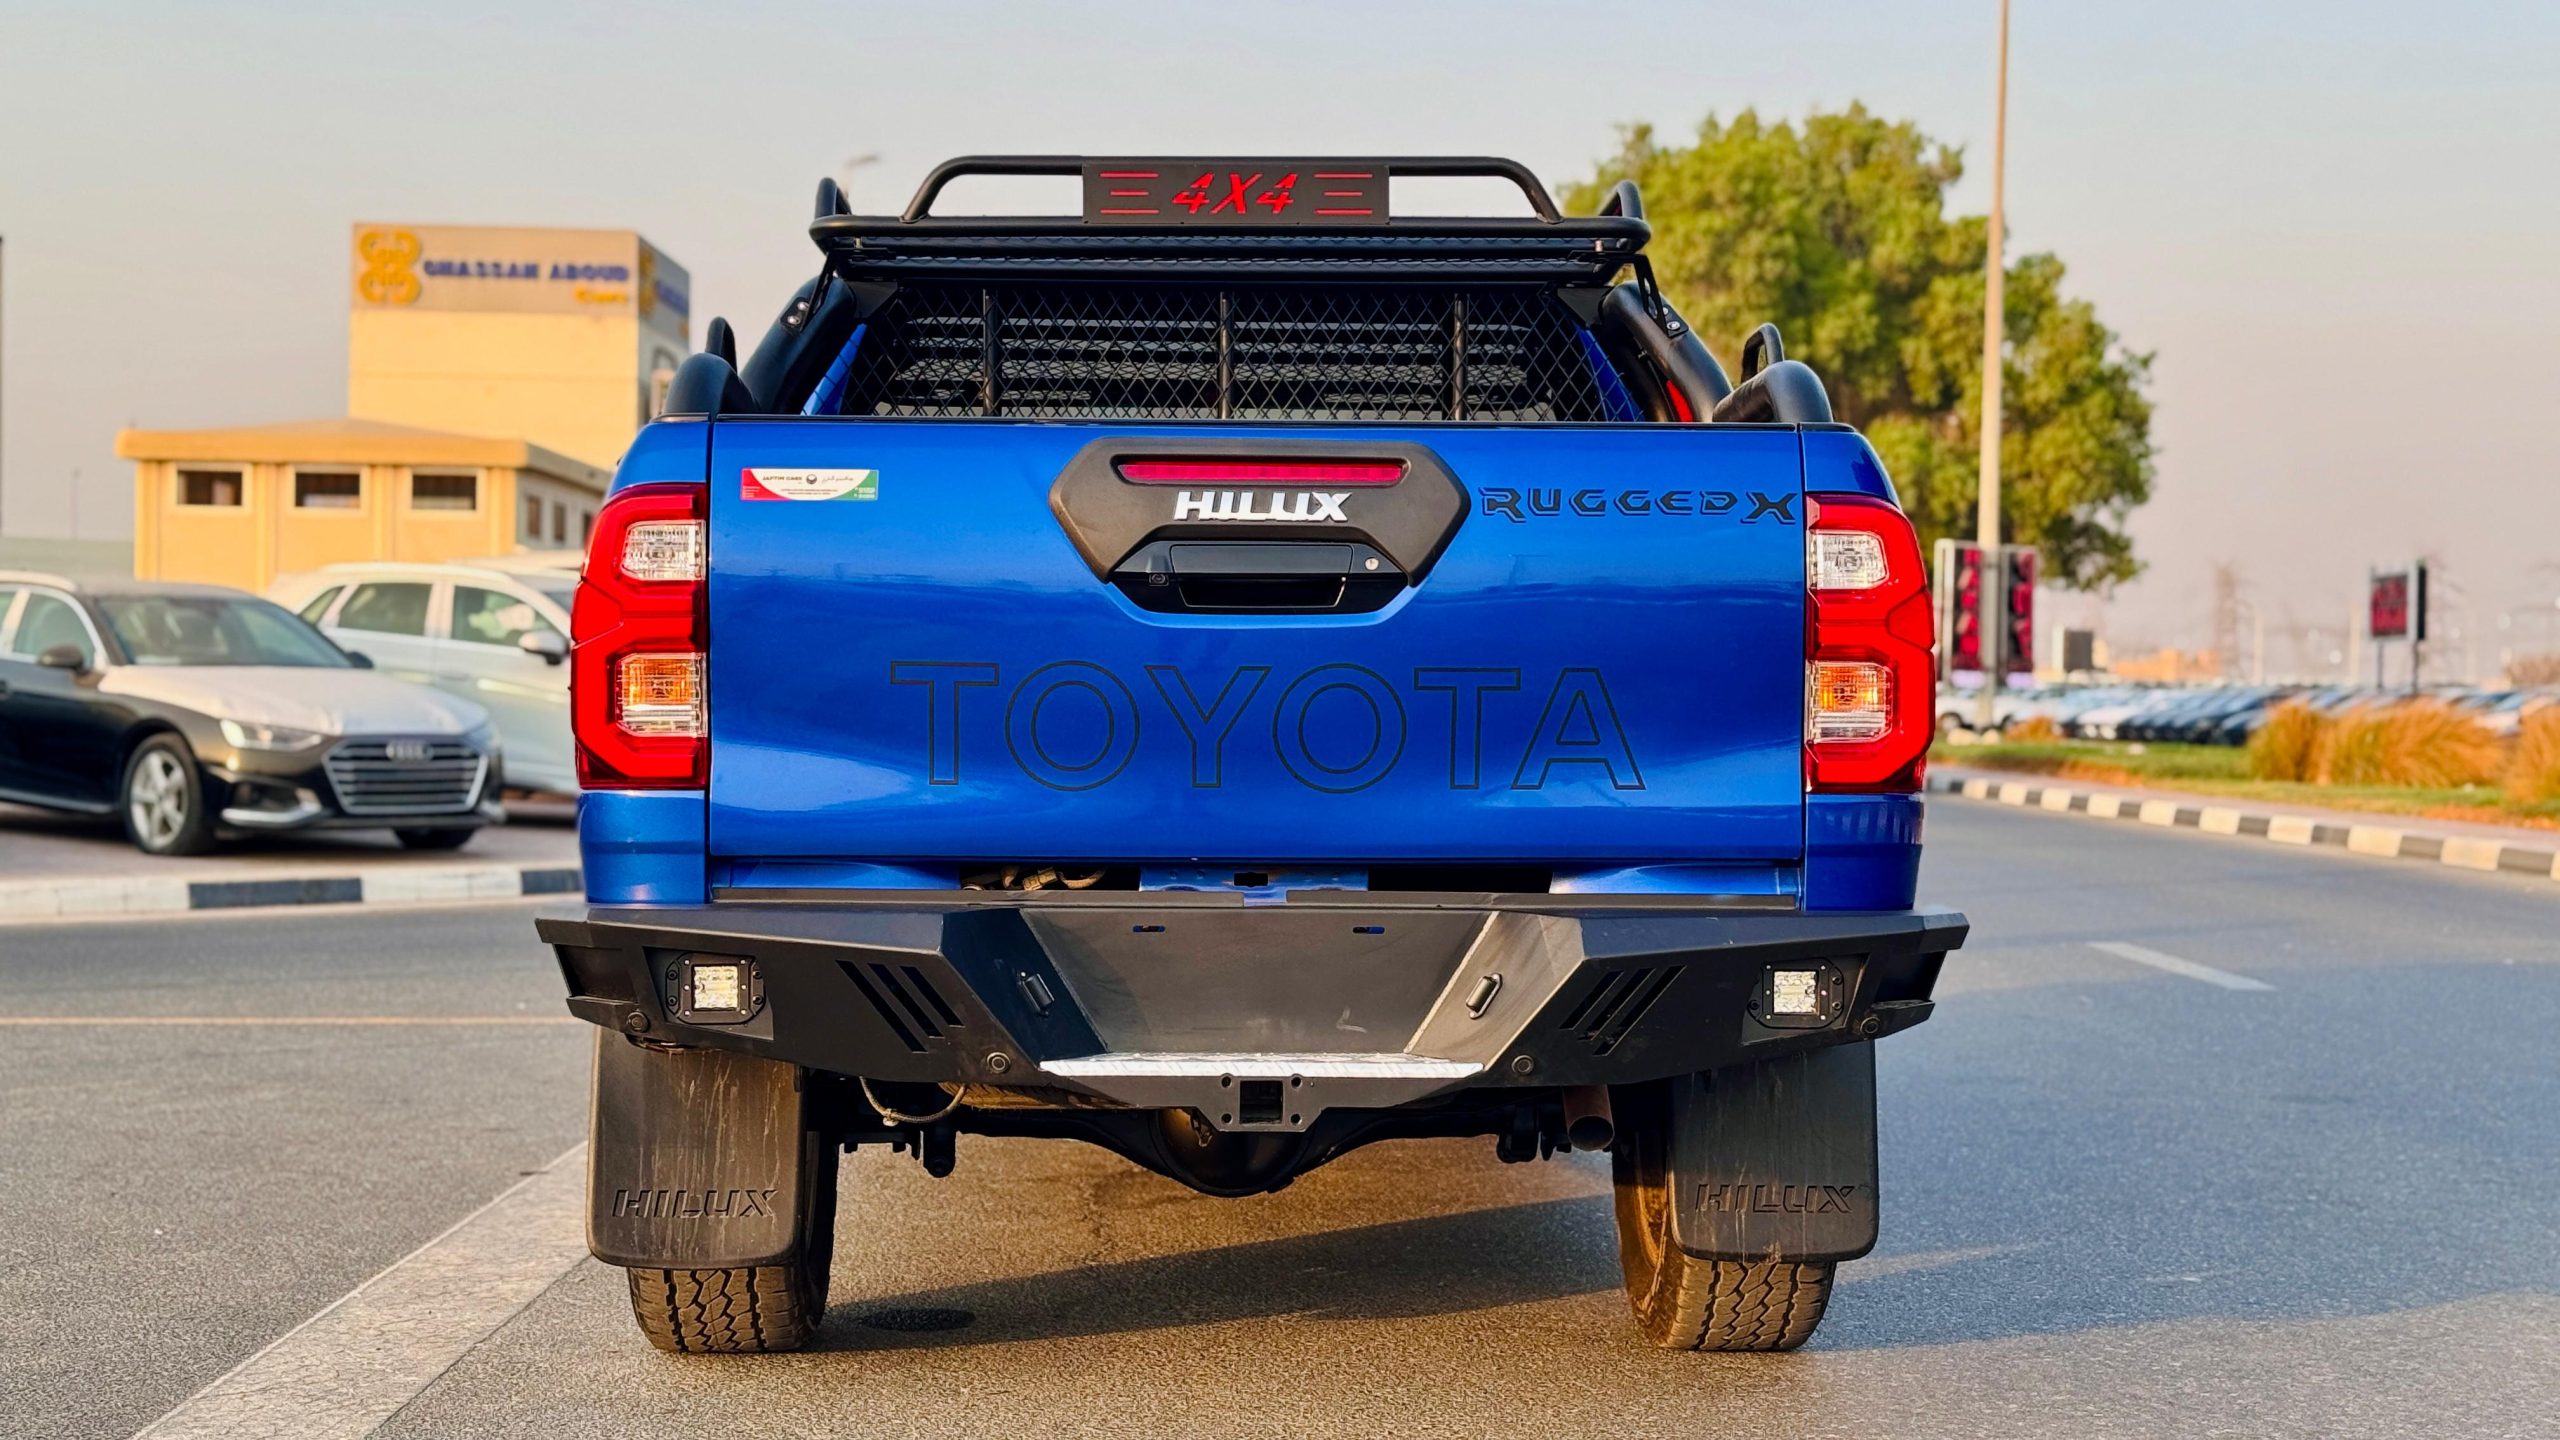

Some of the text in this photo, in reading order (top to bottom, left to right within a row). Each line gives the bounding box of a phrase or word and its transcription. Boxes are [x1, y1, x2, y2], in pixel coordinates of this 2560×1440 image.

[1172, 172, 1298, 215] 4X4
[1173, 491, 1353, 522] HILUX
[890, 659, 1646, 793] TOYOTA
[612, 1189, 778, 1218] HILUX
[1695, 1184, 1856, 1213] HILUX
